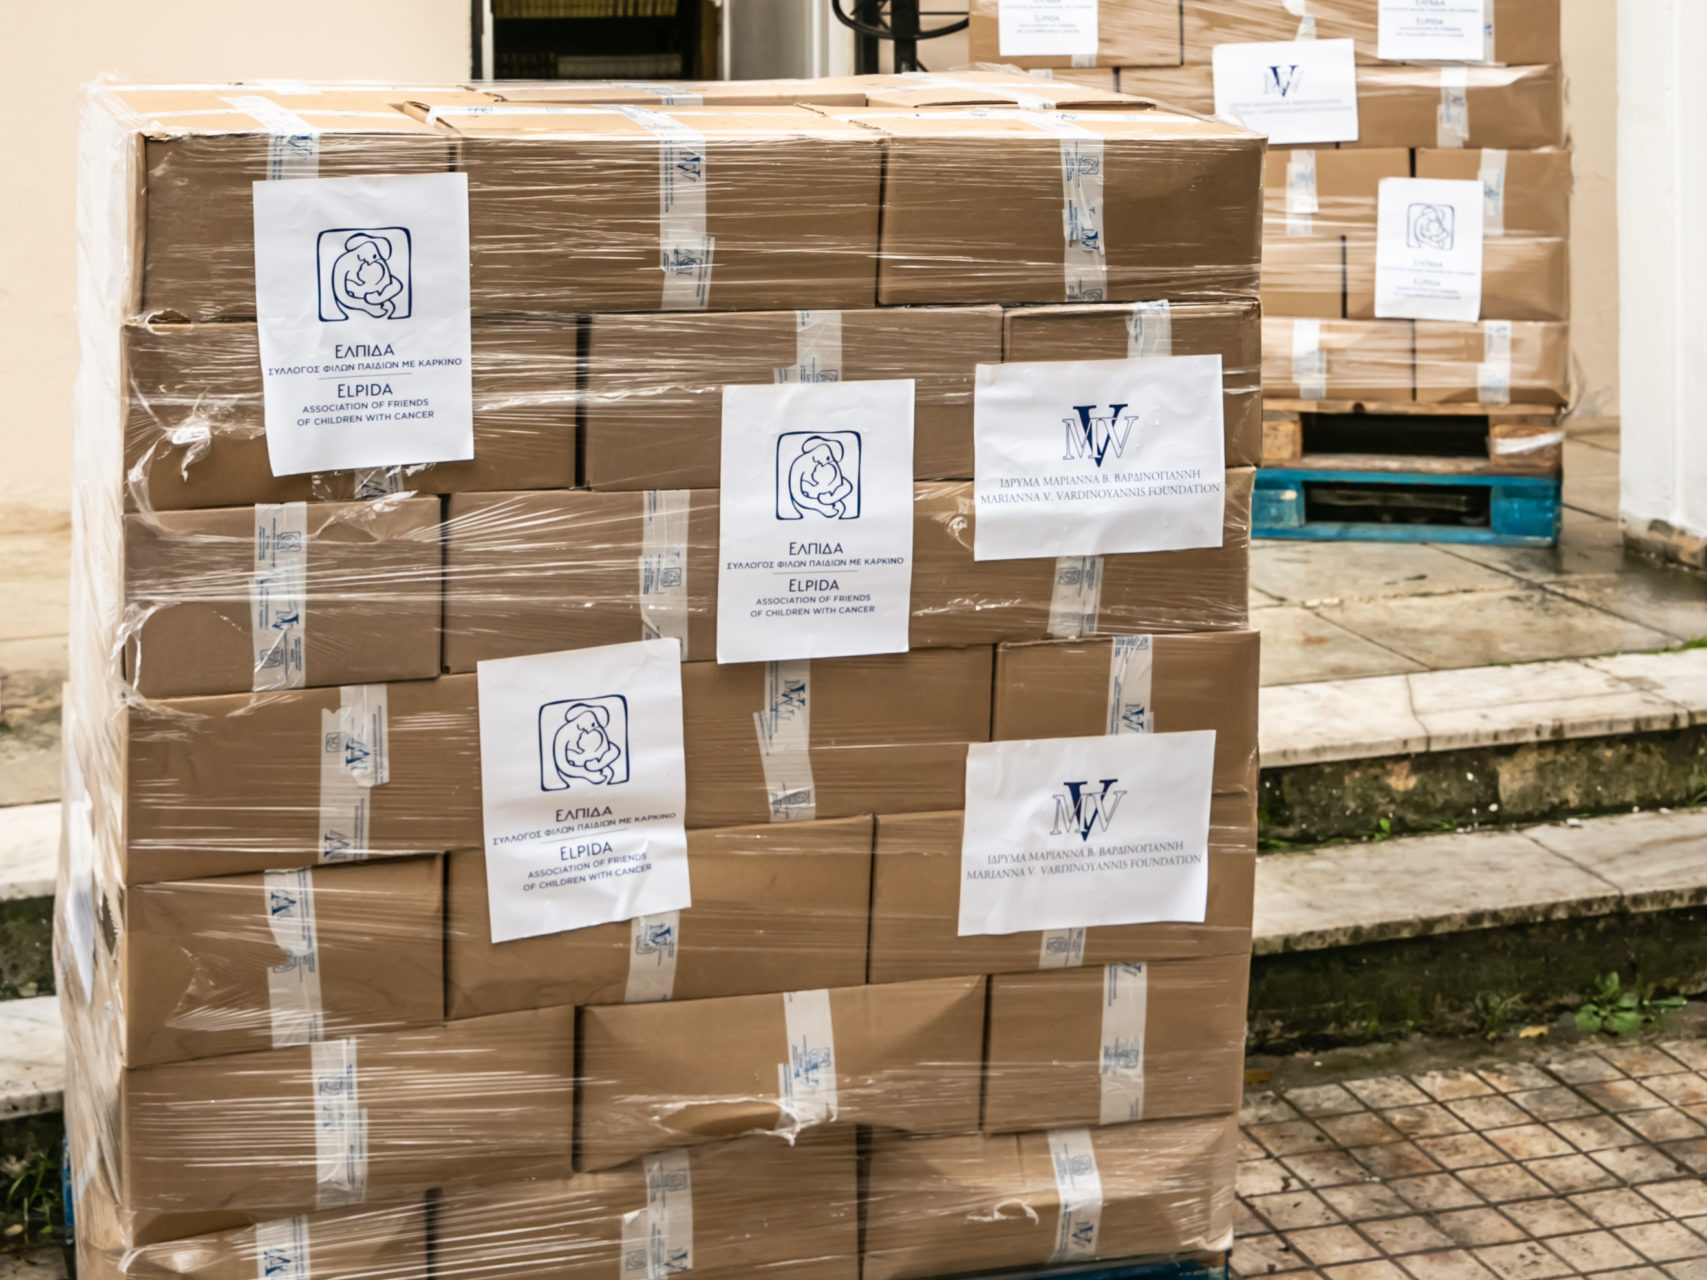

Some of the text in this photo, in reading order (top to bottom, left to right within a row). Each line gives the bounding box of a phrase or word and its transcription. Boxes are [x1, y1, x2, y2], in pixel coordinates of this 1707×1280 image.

[335, 343, 395, 359] ΕΛΠΙΔΑ
[268, 358, 462, 376] ΣΥΛΛΟΓΟΣ ΦΙΛΩΝ ΠΑΙΔΙΩΝ ΜΕ ΚΑΡΚΙΝΟ
[338, 383, 393, 398] ELPIDA
[302, 399, 429, 413] ASSOCIATION OF FRIENDS
[297, 411, 434, 427] OF CHILDREN WITH CANCER
[1000, 477, 1040, 489] ΙΔΡΥΜΑ
[1043, 474, 1100, 487] ΜΑΡΙΑΝΝΑ
[1114, 469, 1201, 483] ΒΑΡΔΙΝΟΓΙΑΝΝΗ
[980, 492, 1041, 504] MARIANNA
[1056, 487, 1145, 501] VARDINOYANNIS
[1148, 483, 1220, 497] FOUNDATION
[789, 542, 844, 556] ΕΛΠΙΔΑ
[726, 557, 904, 570] ΣΥΛΛΟΓΟΣ ΦΙΛΩΝ ΠΑΙΔΙΩΝ ΜΕ ΚΑΡΚΙΝΟ
[789, 578, 840, 592] ELPIDA
[755, 596, 816, 605] ASSOCIATION
[833, 594, 871, 602] FRIENDS
[765, 608, 810, 617] CHILDREN
[813, 607, 836, 615] WITH
[838, 605, 875, 614] CANCER
[555, 806, 613, 822] ΕΛΠΙΔΑ
[492, 831, 542, 846] ΣΥΛΛΟΓΟΣ
[544, 825, 575, 837] ΦΙΛΩΝ
[577, 819, 616, 831] ΠΑΙΔΙΩΝ
[560, 841, 613, 861] ELPIDA
[988, 852, 1026, 865] ΙΔΡΥΜΑ
[1028, 848, 1085, 862] ΜΑΡΙΑΝΝΑ
[1099, 841, 1184, 856] ΒΑΡΔΙΝΟΓΙΑΝΝΗ
[527, 852, 647, 879] ASSOCIATION OF FRIENDS
[966, 867, 1026, 880] MARIANNA
[1040, 860, 1128, 875] VARDINOYANNIS
[1130, 855, 1202, 868] FOUNDATION
[523, 864, 652, 892] OF CHILDREN WITH CANCER
